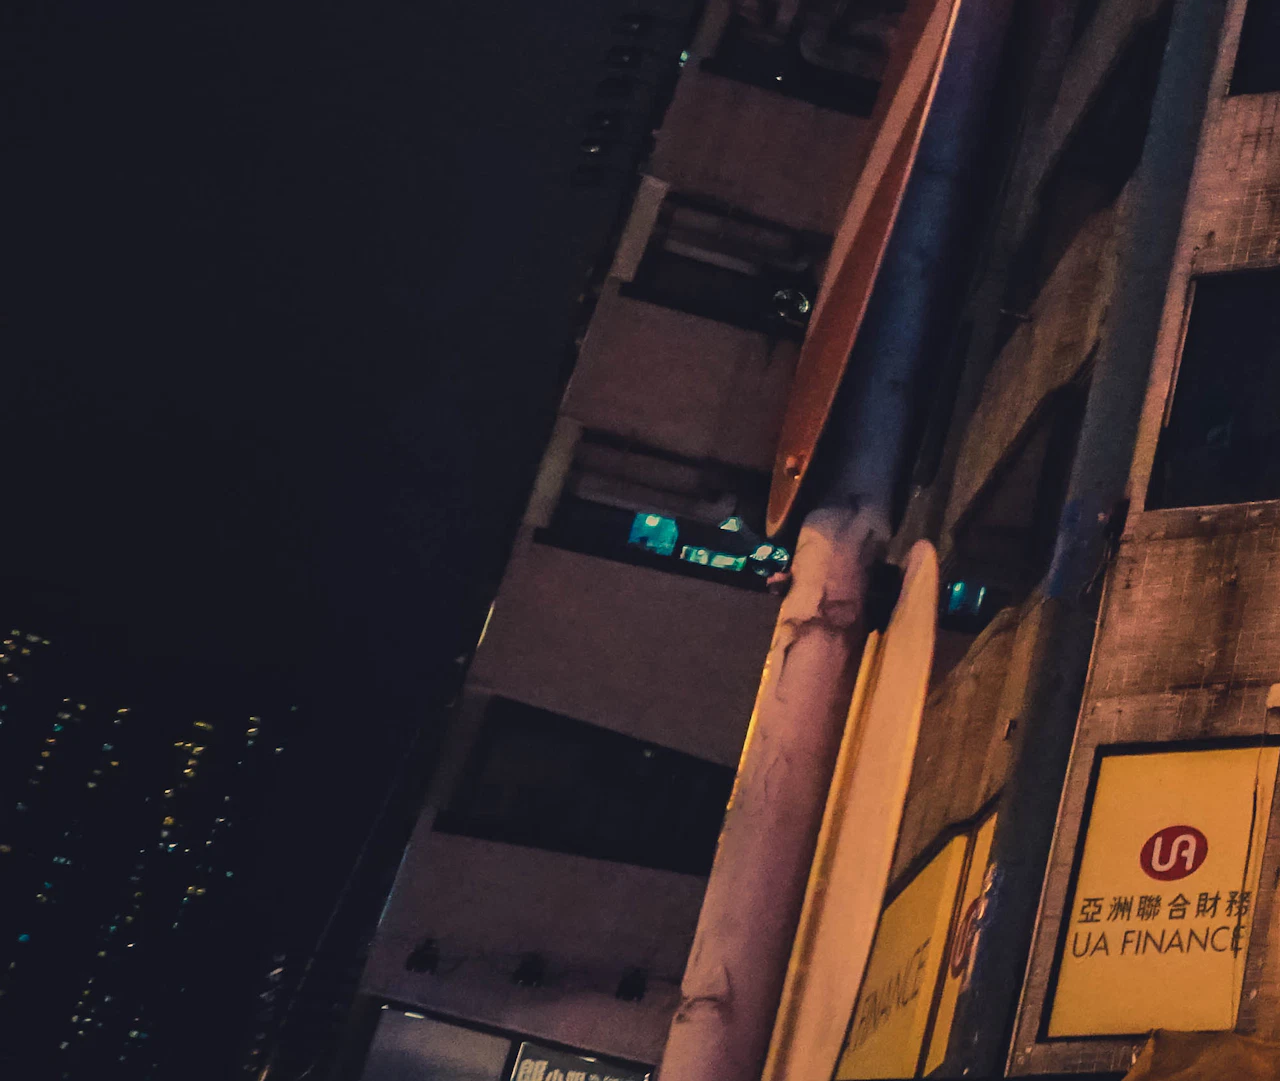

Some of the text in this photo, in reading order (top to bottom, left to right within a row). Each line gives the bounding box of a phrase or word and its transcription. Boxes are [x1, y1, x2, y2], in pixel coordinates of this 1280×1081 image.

[1077, 891, 1252, 924] 亞洲聯合財務
[1072, 926, 1246, 958] UA FINANCE
